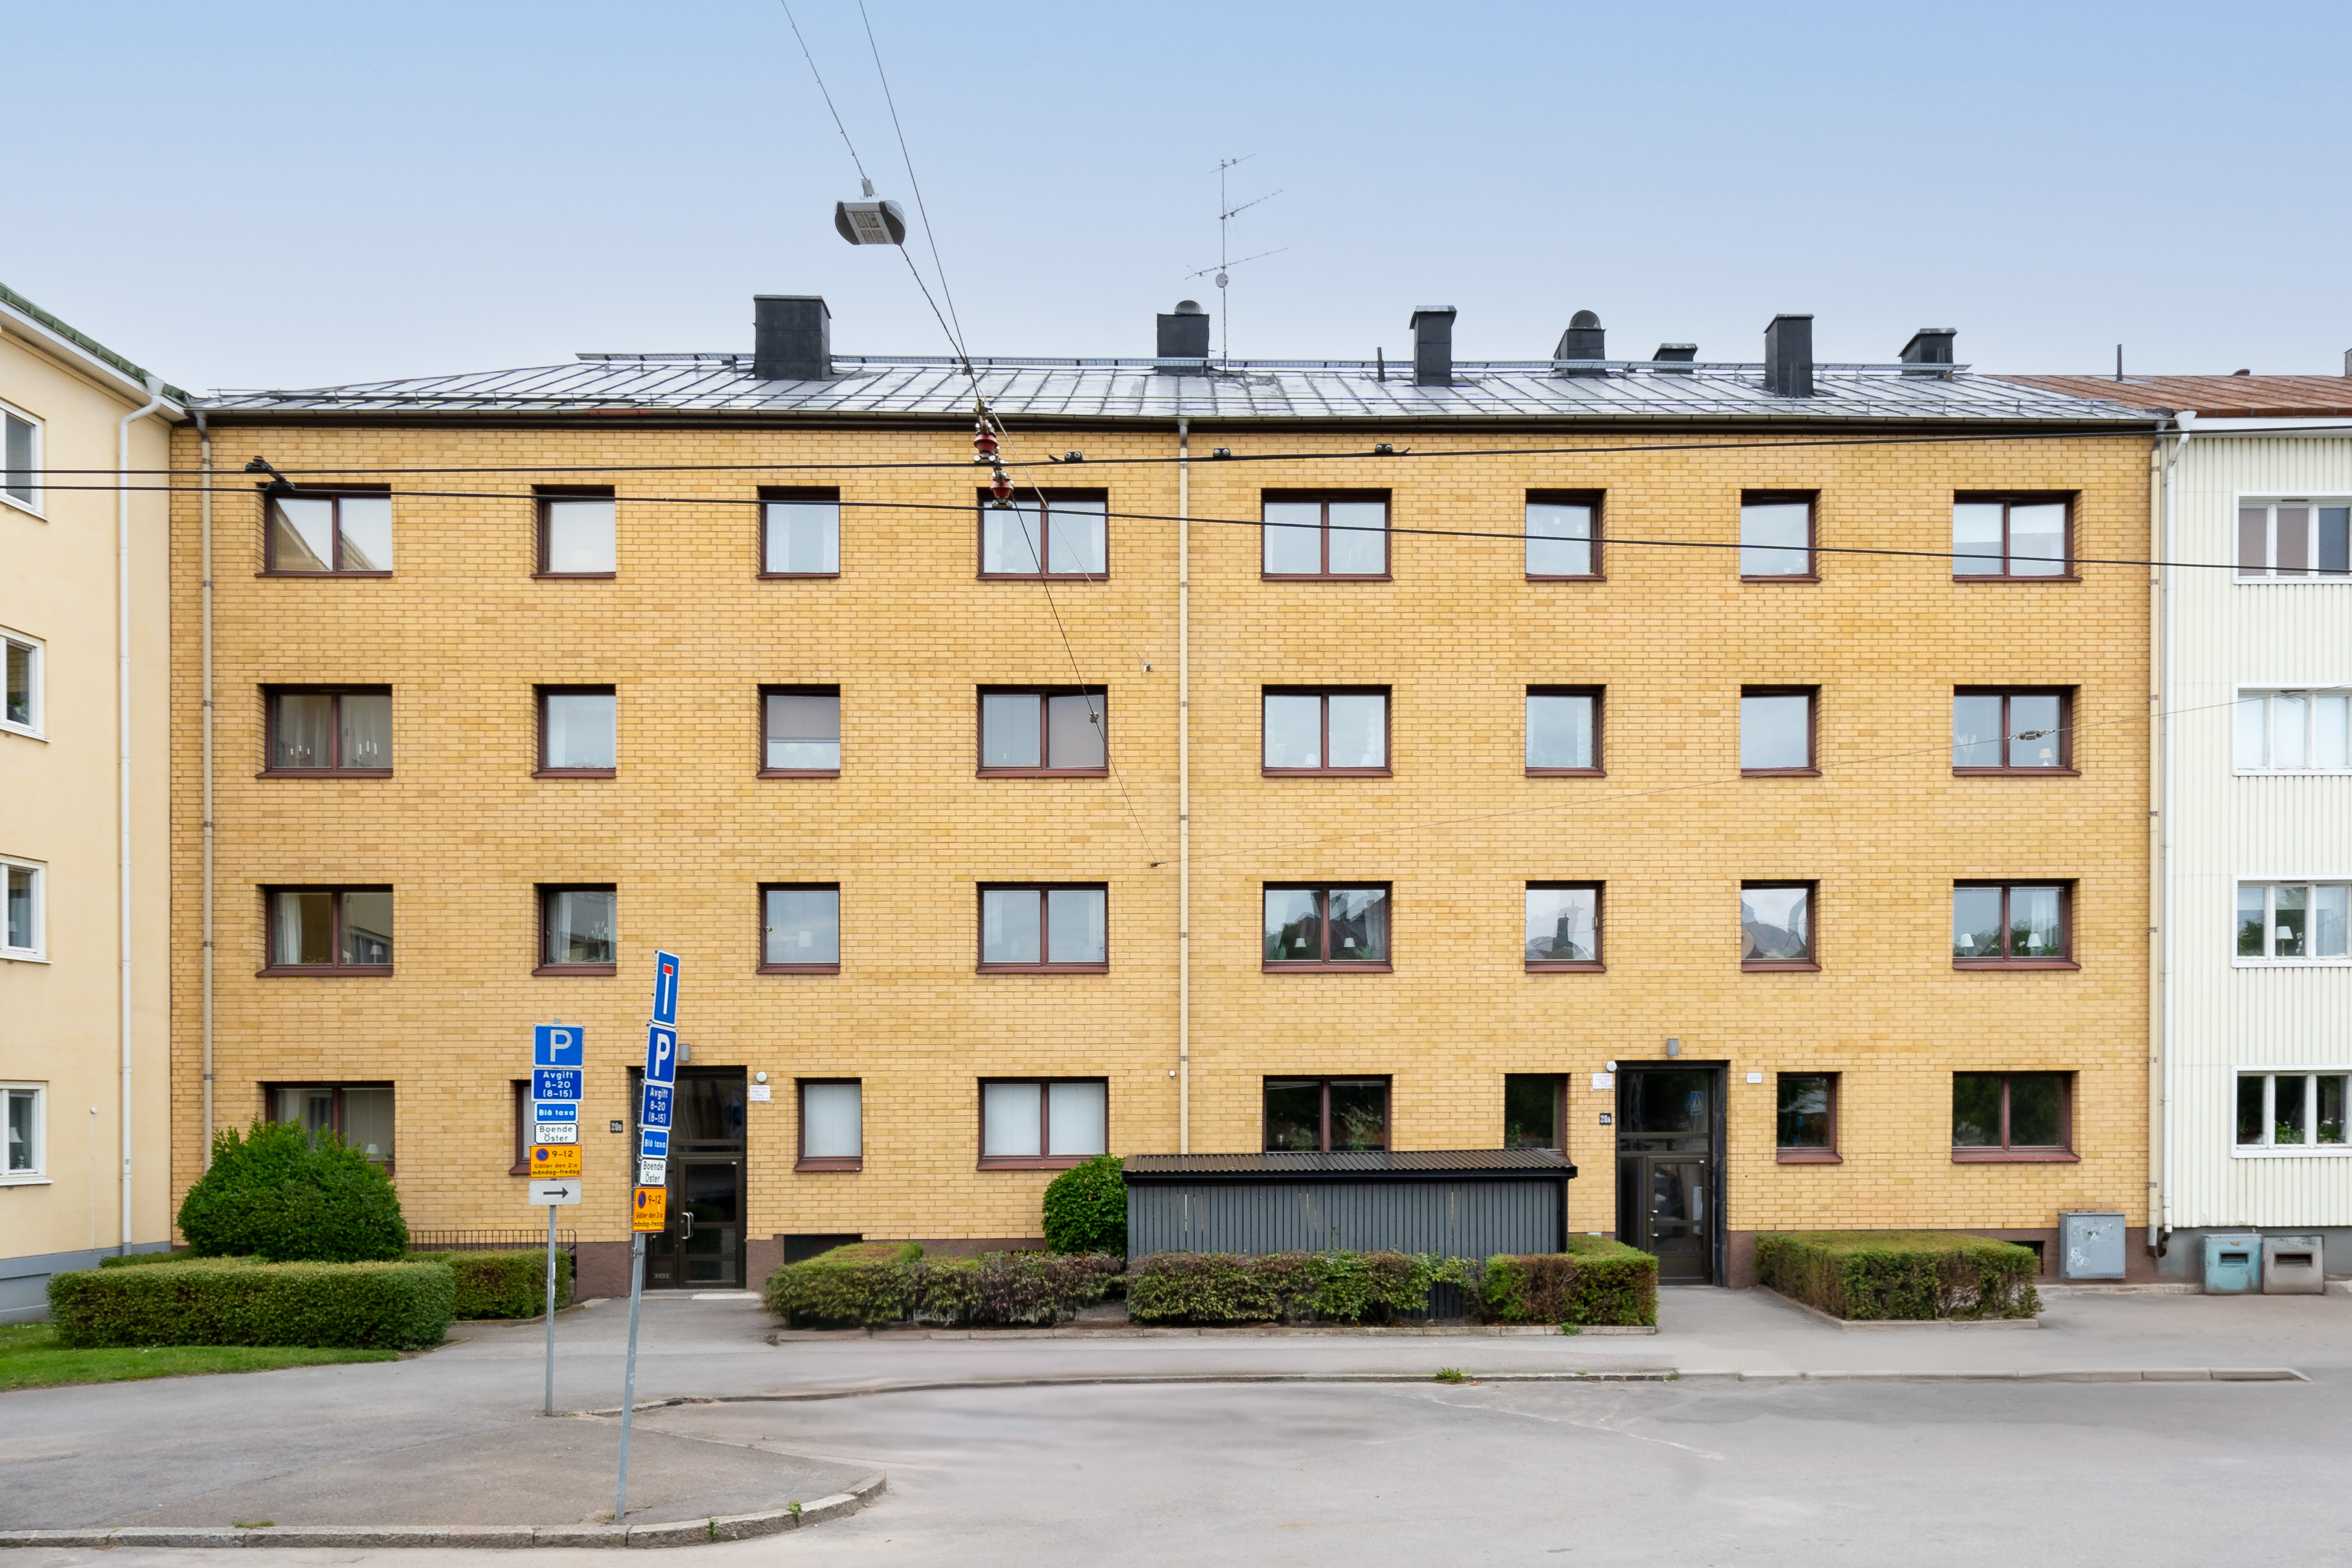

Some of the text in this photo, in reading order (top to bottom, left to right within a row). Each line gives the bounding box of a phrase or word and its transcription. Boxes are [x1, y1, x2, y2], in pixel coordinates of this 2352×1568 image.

[549, 1029, 572, 1062] P
[655, 1033, 671, 1077] P
[543, 1071, 573, 1080] Avgift
[545, 1081, 571, 1089] 8-20
[542, 1089, 573, 1098] (8-15)
[650, 1087, 668, 1100] Avgift
[650, 1100, 666, 1111] 8-20
[648, 1111, 666, 1124] (8-15)
[1600, 1115, 1611, 1123] 20A
[544, 1133, 568, 1142] Öster
[654, 1139, 666, 1148] taxa
[552, 1150, 573, 1158] 9-12
[643, 1161, 664, 1170] Boende
[645, 1171, 660, 1183] Öster
[648, 1195, 662, 1204] 9-12
